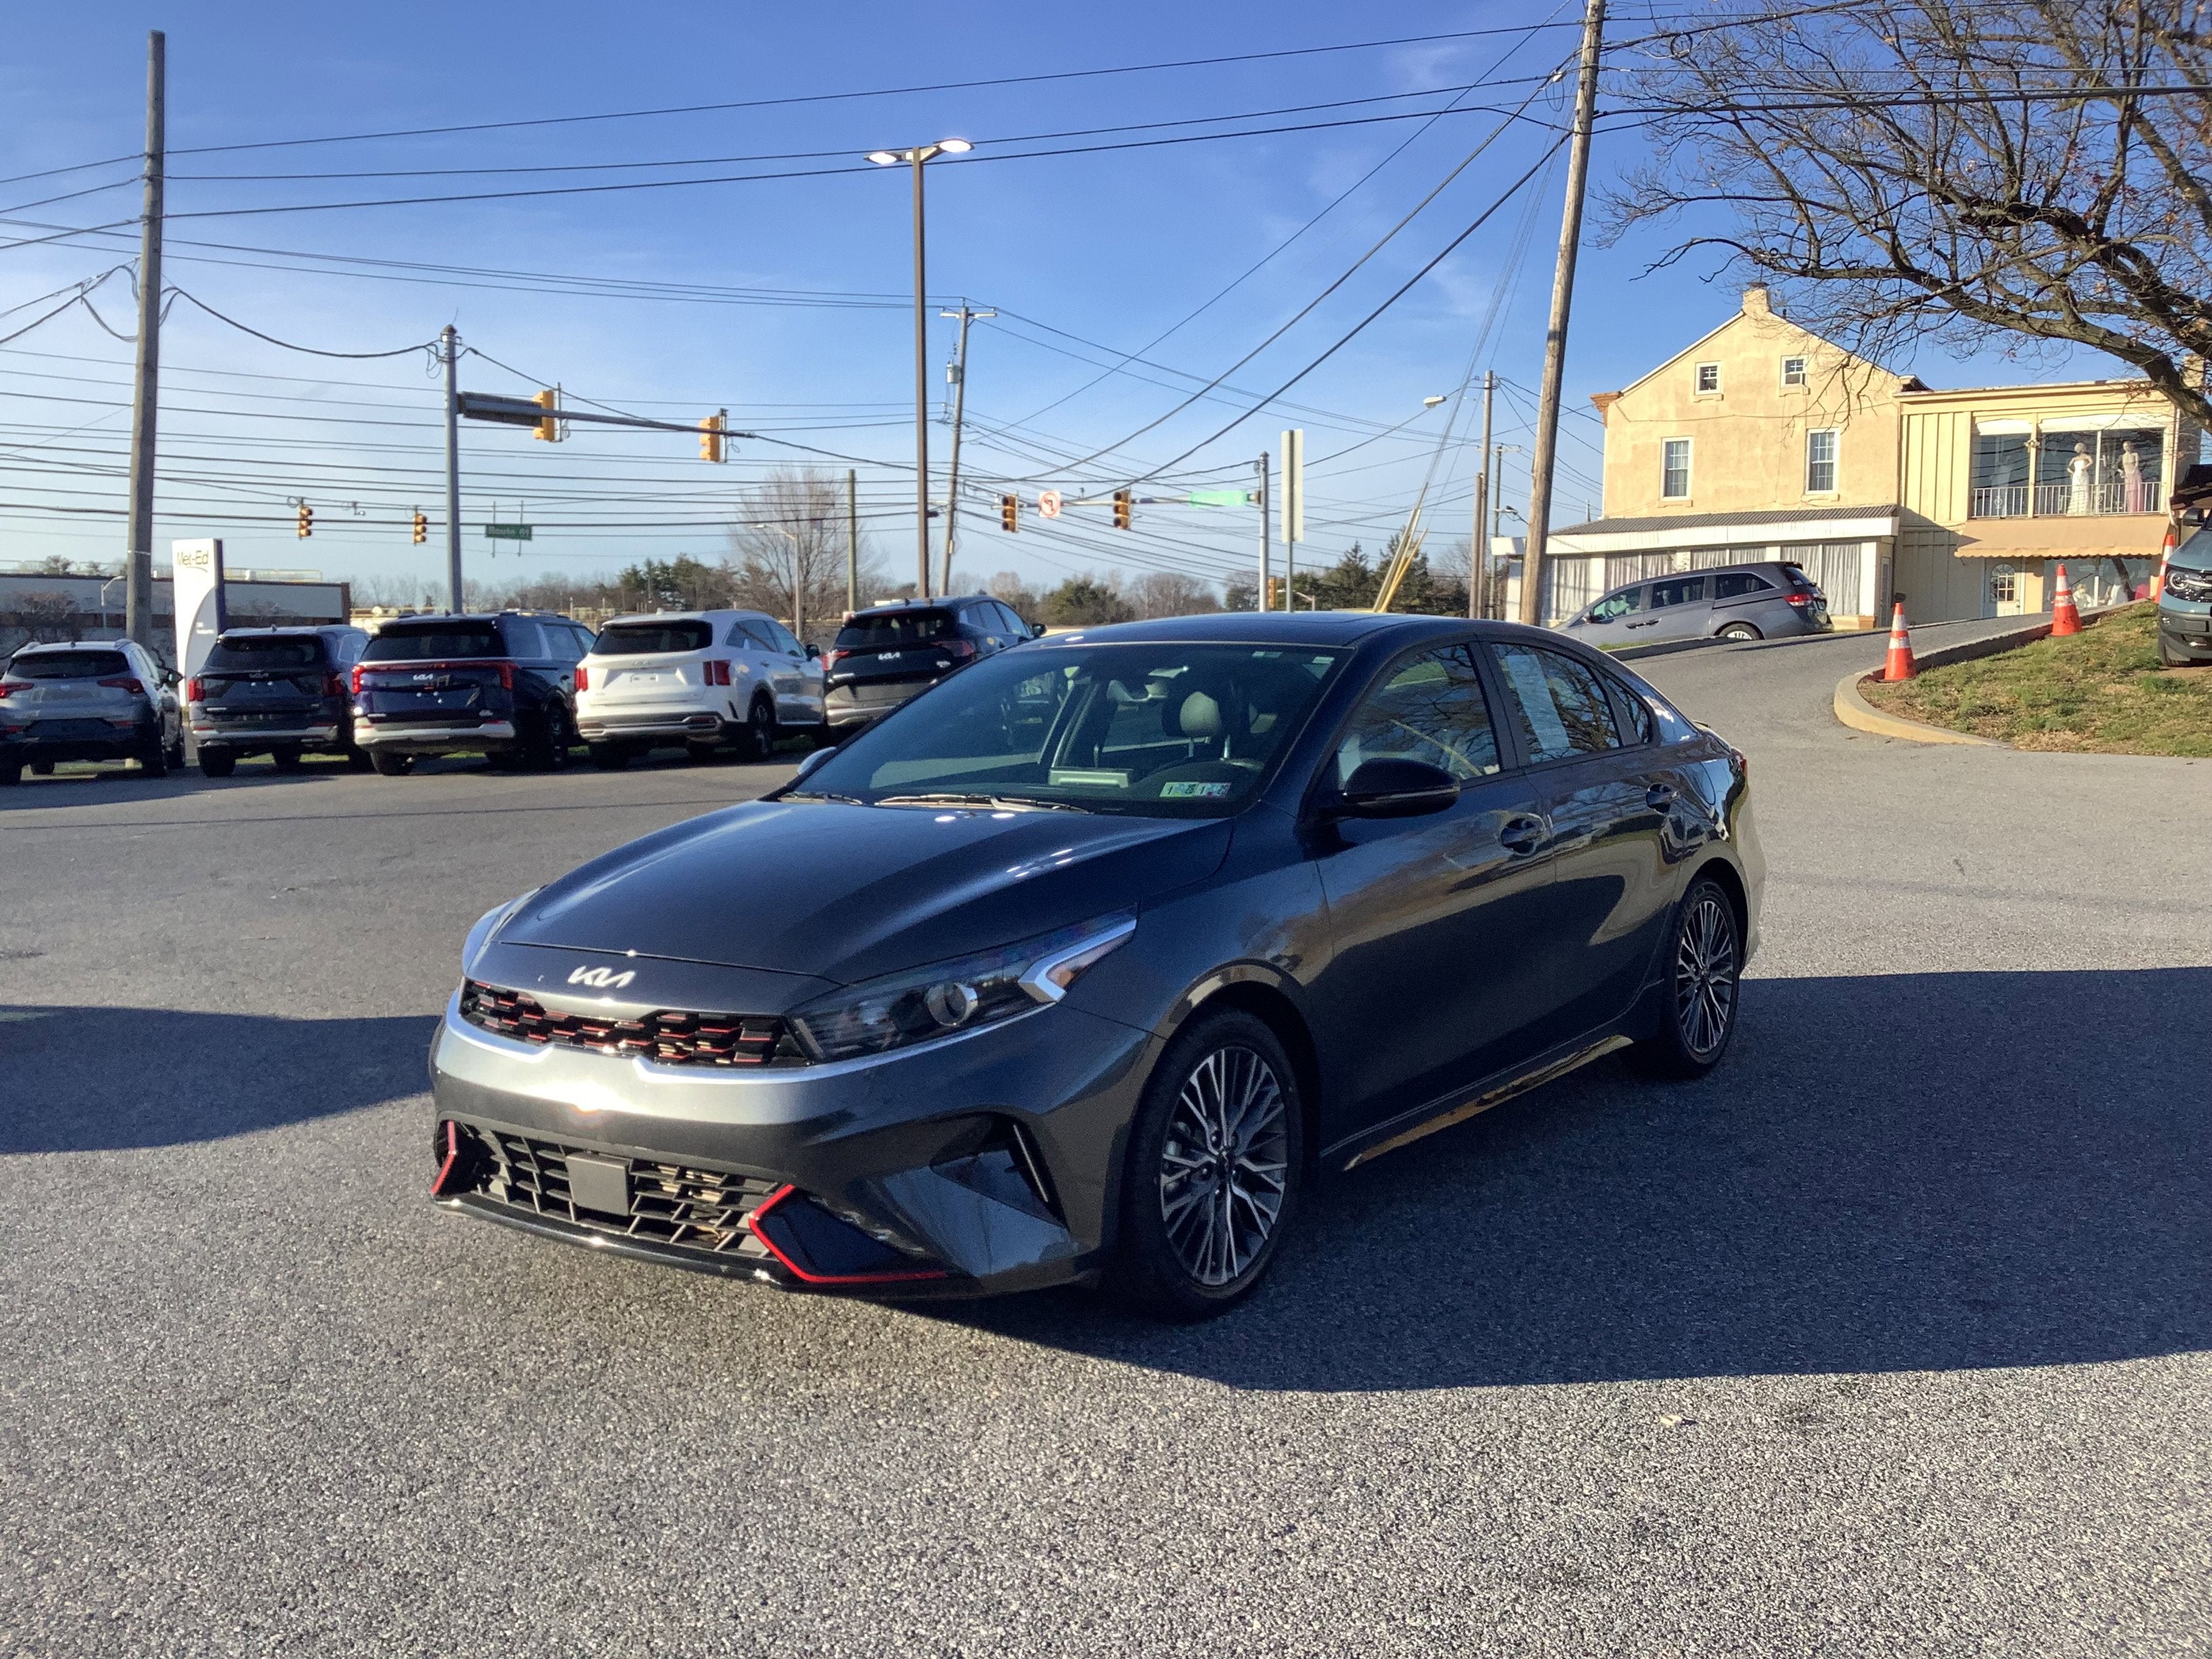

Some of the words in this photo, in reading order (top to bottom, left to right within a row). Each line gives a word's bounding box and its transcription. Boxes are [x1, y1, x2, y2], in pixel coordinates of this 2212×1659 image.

[177, 550, 209, 565] Met-Ed
[878, 652, 901, 660] KIA
[567, 965, 636, 989] KIA
